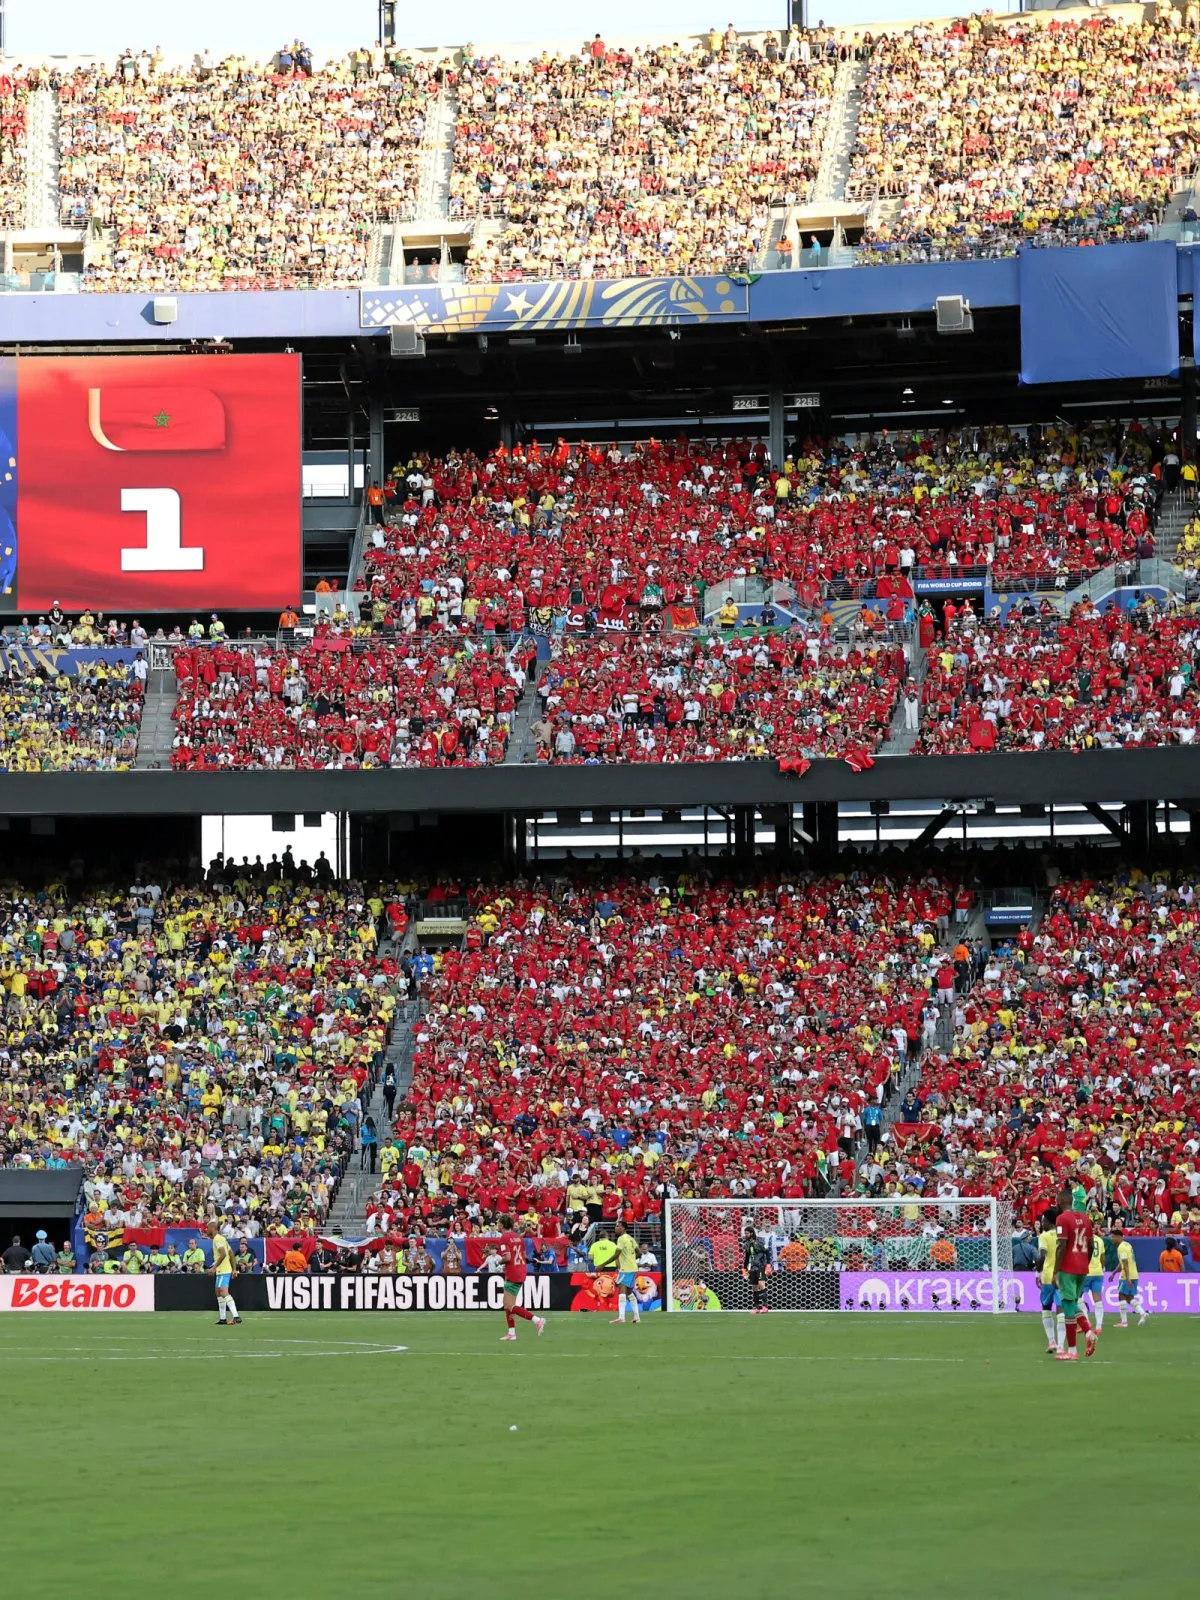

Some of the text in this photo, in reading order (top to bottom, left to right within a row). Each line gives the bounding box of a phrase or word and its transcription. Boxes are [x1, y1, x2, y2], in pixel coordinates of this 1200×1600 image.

[734, 400, 758, 408] 224B
[795, 398, 820, 406] 225B
[395, 413, 419, 421] 224B
[120, 487, 204, 572] 1
[1072, 1227, 1088, 1253] 14
[11, 1278, 136, 1309] Betano
[266, 1275, 335, 1310] VISIT
[895, 1278, 1025, 1305] kraken
